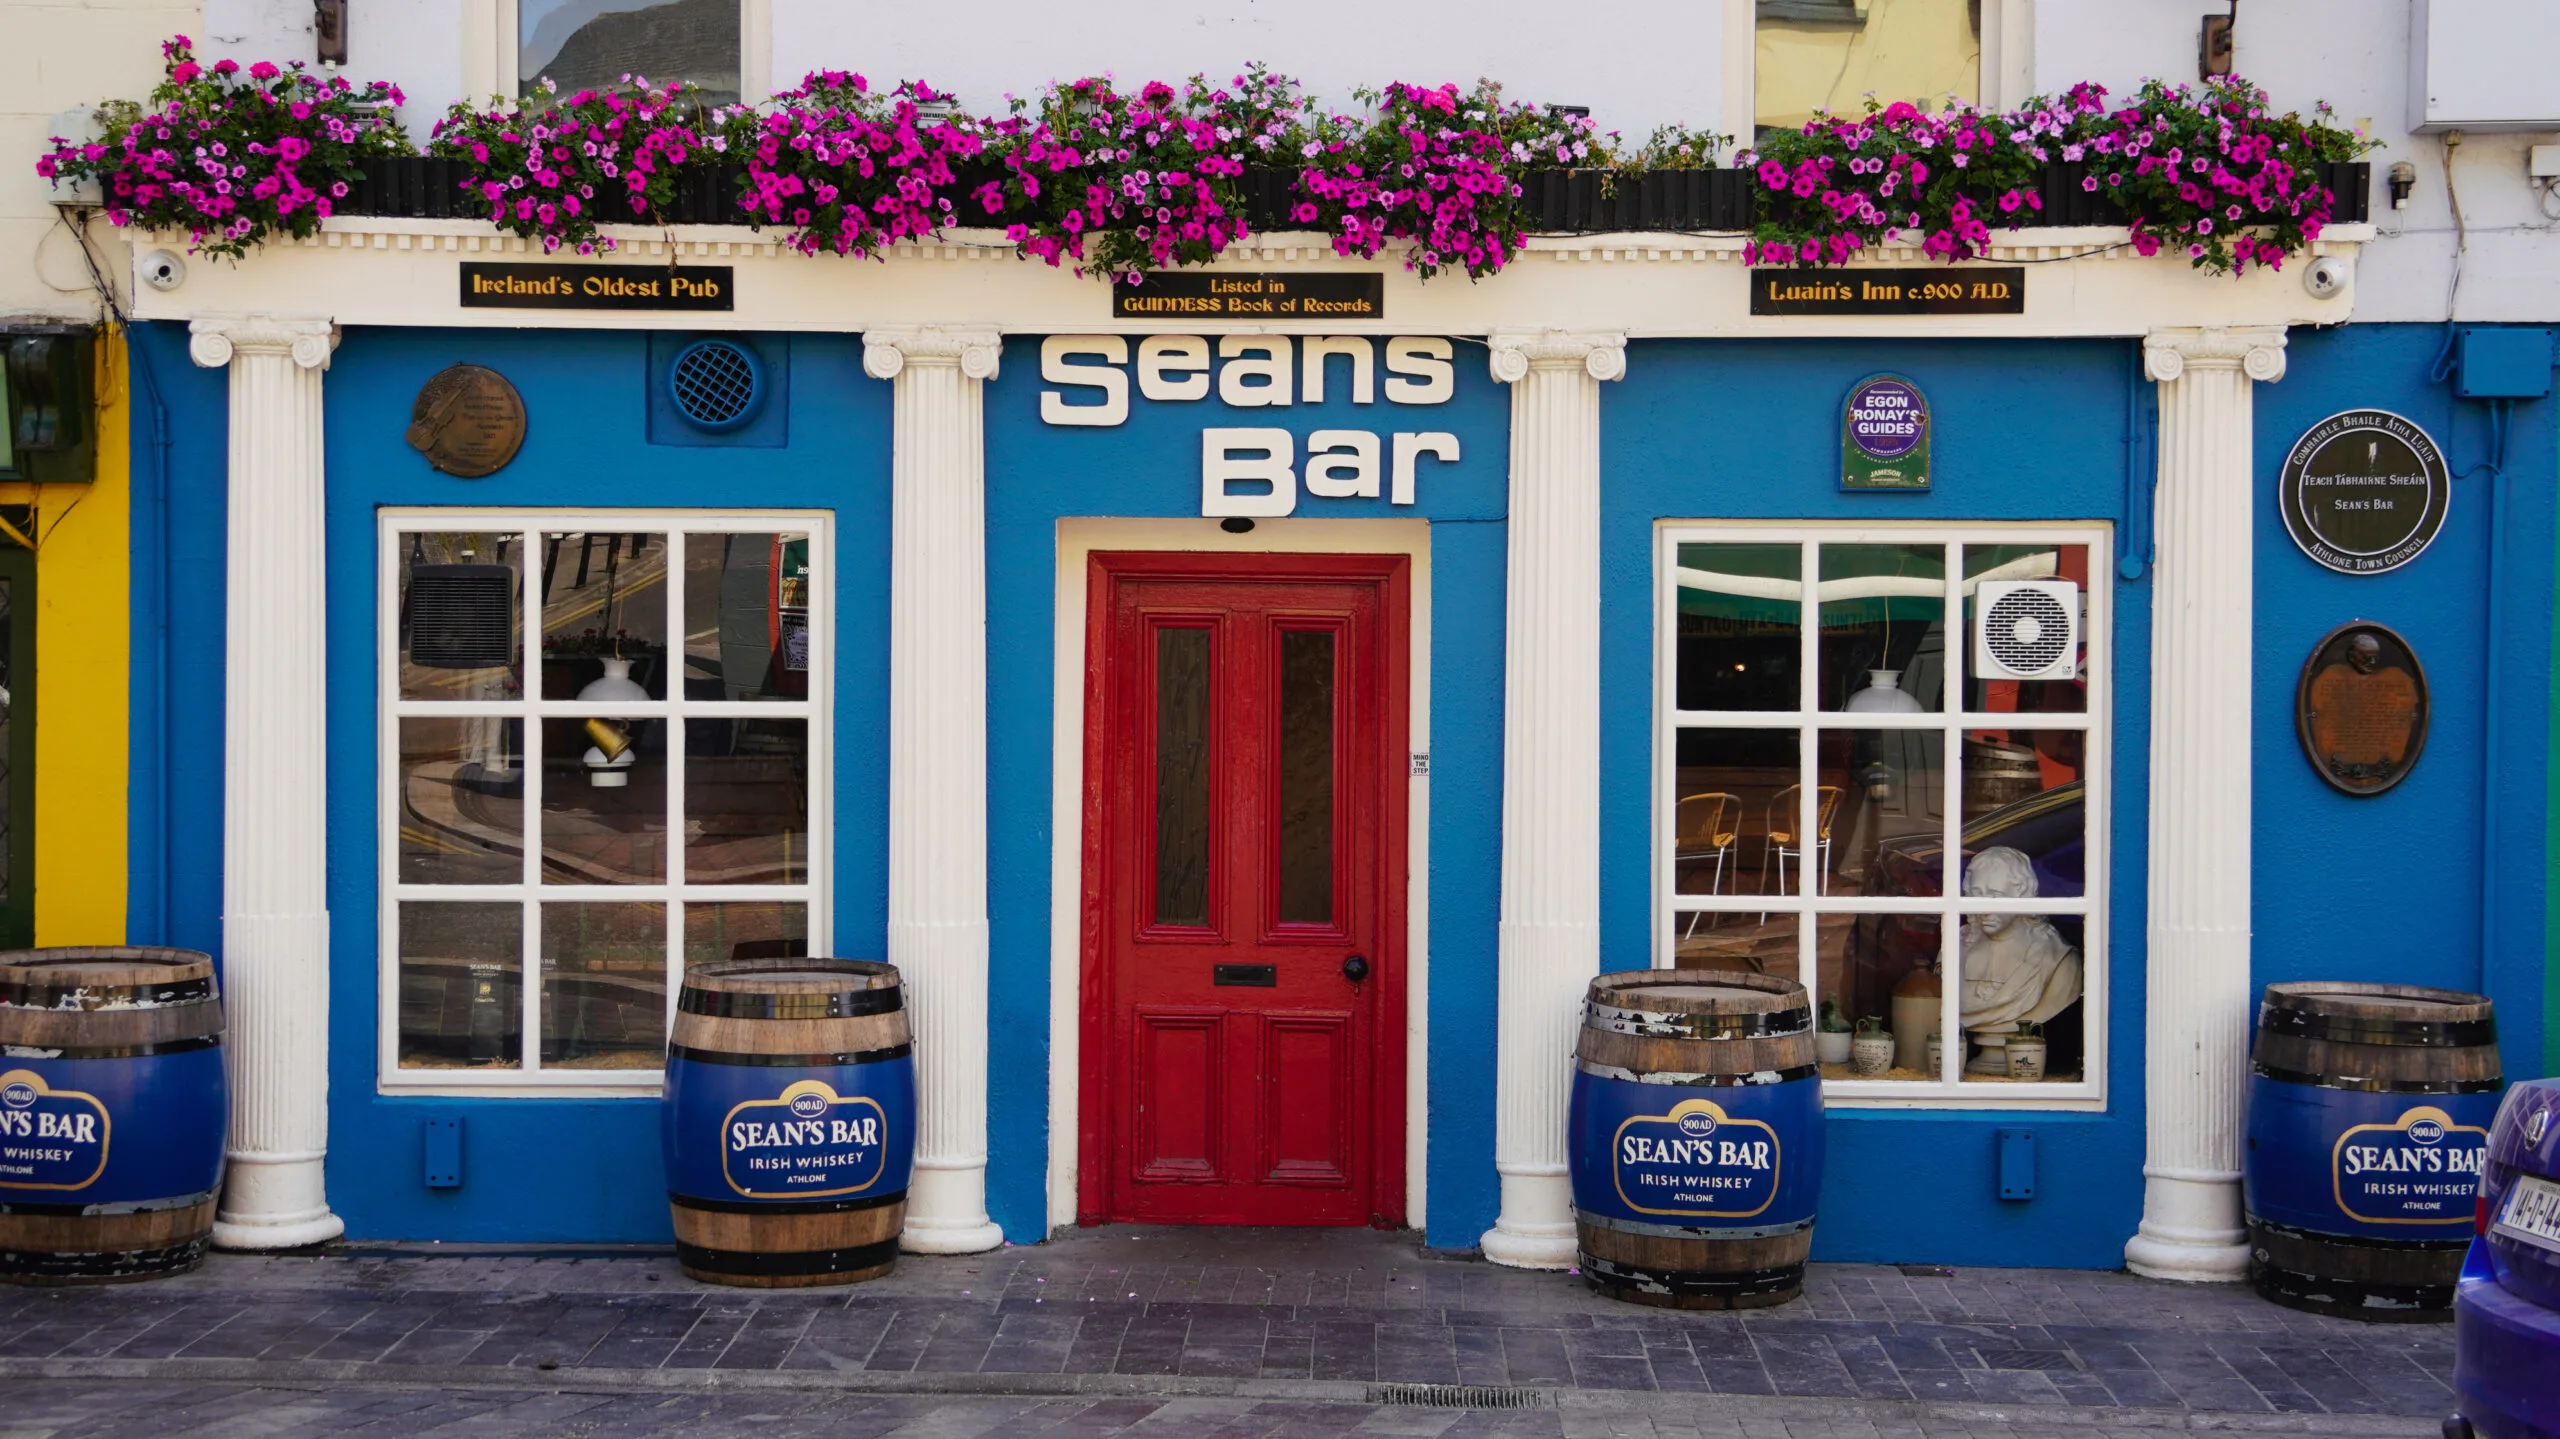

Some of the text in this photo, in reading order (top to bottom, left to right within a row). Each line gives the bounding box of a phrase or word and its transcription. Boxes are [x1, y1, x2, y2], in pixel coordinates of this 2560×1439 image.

[473, 274, 719, 298] Ireland's Oldest Pub
[1210, 279, 1285, 293] Listed in
[1770, 280, 2011, 300] Luain's Inn c.900 A.D.
[1124, 298, 1372, 312] GUINNESS Book of Records
[1041, 334, 1454, 426] Seans
[1865, 396, 1908, 408] EGON
[1854, 409, 1919, 421] RONAY'S
[1858, 422, 1915, 434] GUIDES
[1202, 427, 1460, 517] Bar
[2335, 499, 2394, 510] SEAN'S BAR
[2310, 537, 2425, 570] ATHLONE TOWN COUNCIL
[37, 1112, 97, 1143] BAR
[732, 1118, 878, 1151] SEAN'S BAR
[4, 1147, 73, 1161] WHISKEY
[1623, 1135, 1770, 1170] SEAN'S BAR
[750, 1152, 863, 1170] IRISH WHISKEY
[2345, 1146, 2442, 1175] SEAN'S
[787, 1174, 826, 1184] ATHLONE
[1640, 1174, 1752, 1189] IRISH WHISKEY
[2364, 1183, 2475, 1195] IRISH WHISKEY
[1674, 1193, 1714, 1202] ATHLONE
[2402, 1202, 2441, 1210] ATHLONE
